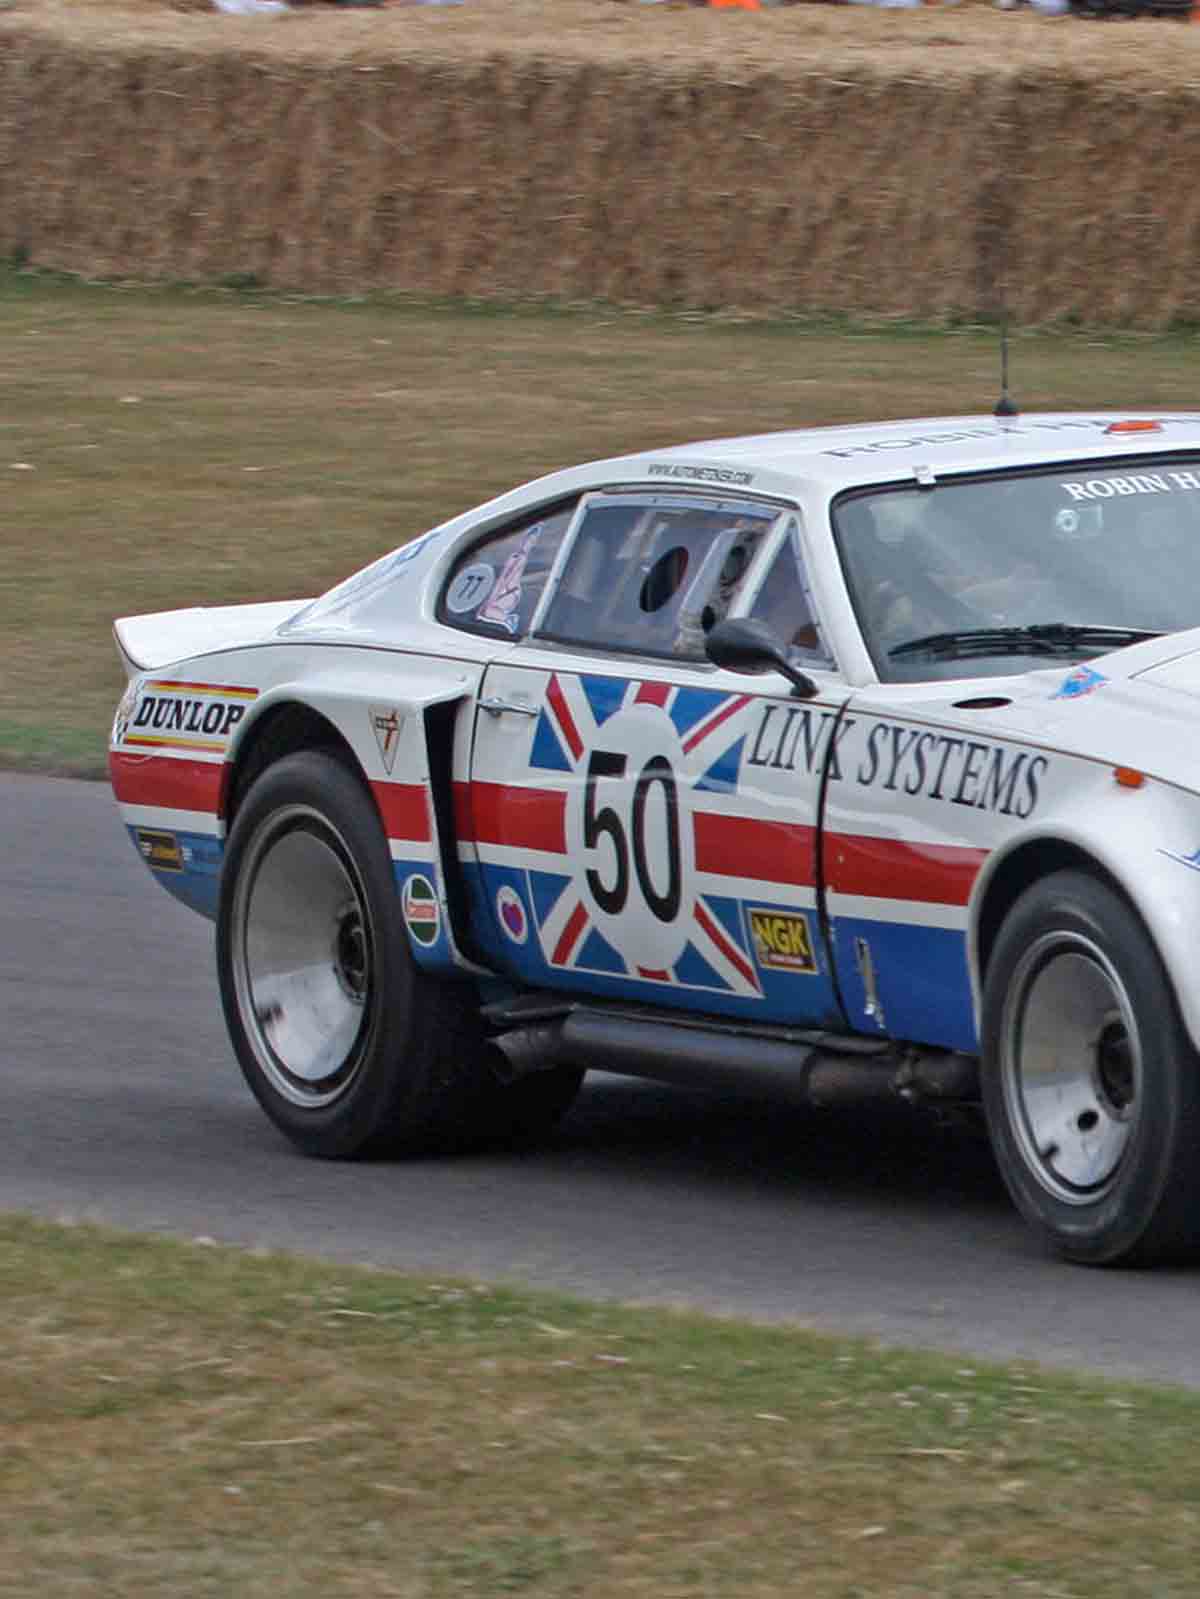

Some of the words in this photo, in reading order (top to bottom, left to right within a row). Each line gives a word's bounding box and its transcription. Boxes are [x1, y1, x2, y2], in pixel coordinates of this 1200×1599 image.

[1061, 474, 1170, 500] ROBIN
[133, 696, 246, 735] DUNLOP
[747, 704, 857, 781] LINK
[857, 721, 1049, 819] SYSTEMS
[583, 750, 681, 922] 50
[751, 917, 809, 955] NGK
